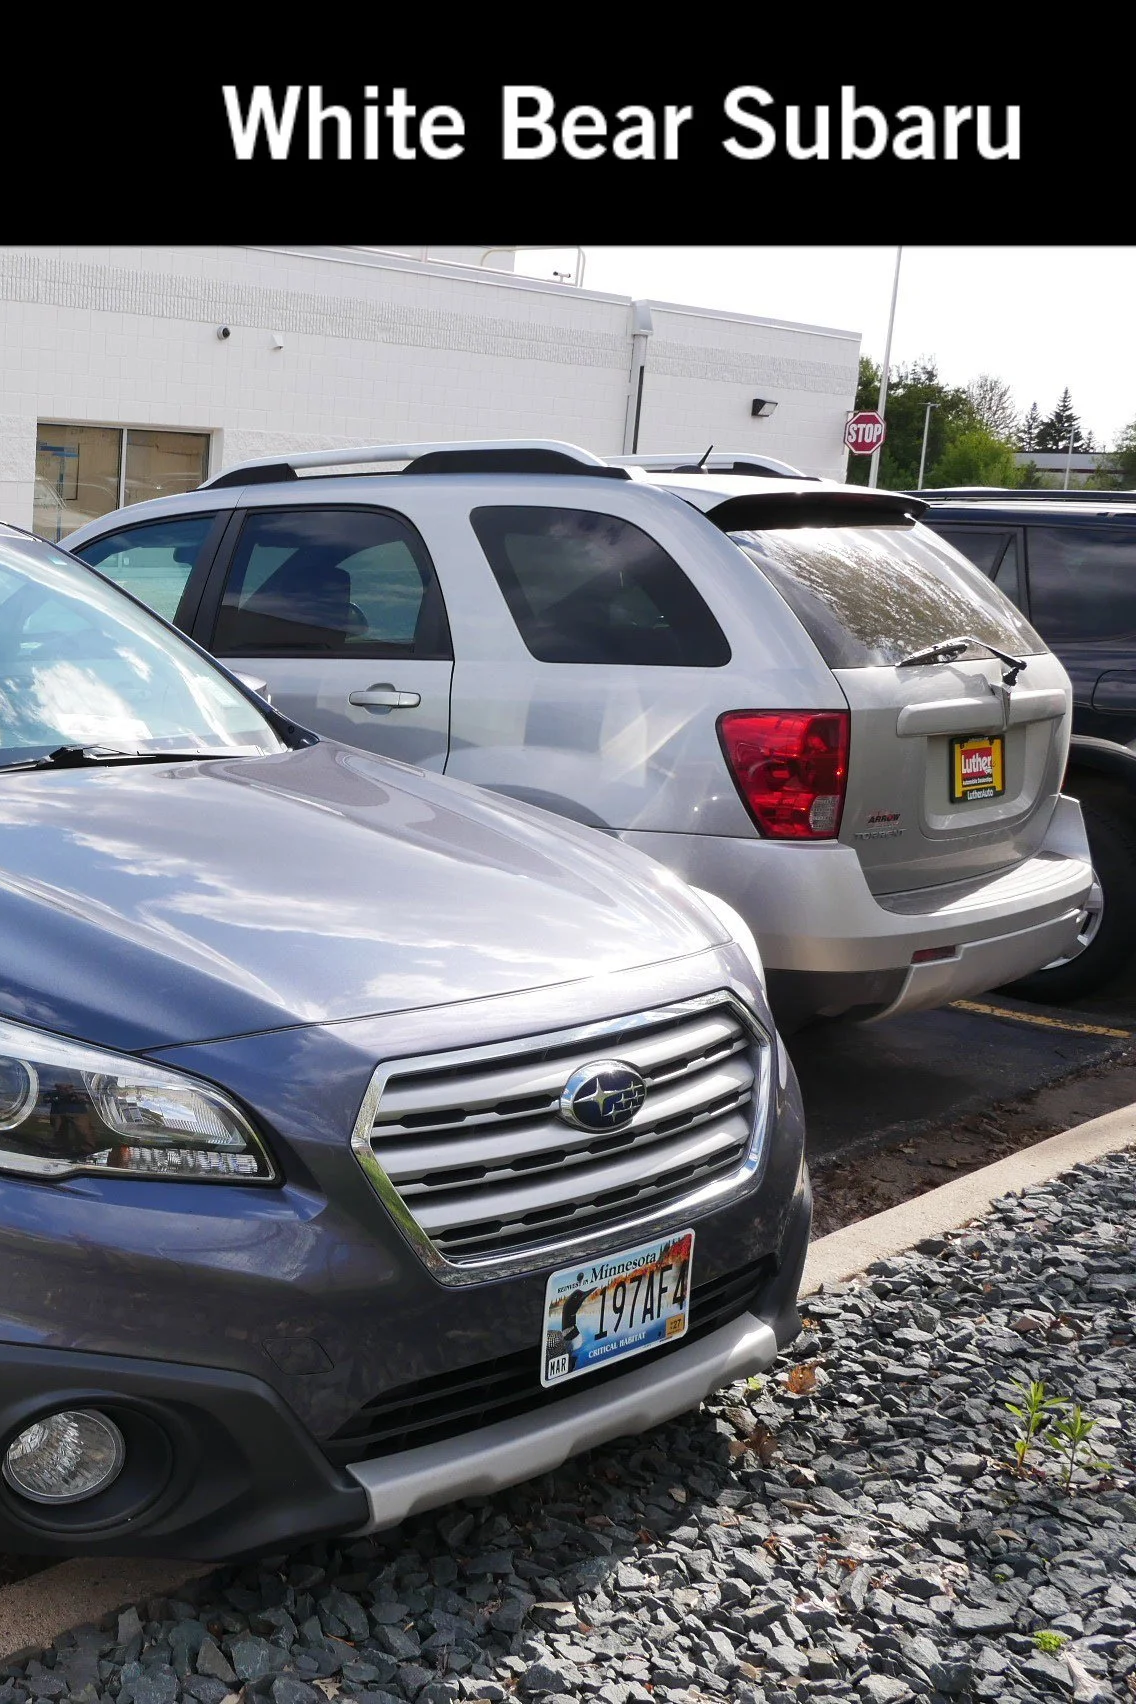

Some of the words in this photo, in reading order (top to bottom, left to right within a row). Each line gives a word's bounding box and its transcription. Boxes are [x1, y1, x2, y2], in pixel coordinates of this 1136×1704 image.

[847, 423, 882, 443] STOP
[961, 753, 993, 774] Luther
[868, 813, 901, 823] ARROW
[590, 1252, 657, 1284] Minnesota
[594, 1259, 690, 1341] 197AF4
[588, 1341, 618, 1359] CRITICAL
[619, 1331, 647, 1348] HABITAT
[549, 1357, 567, 1377] MAR
